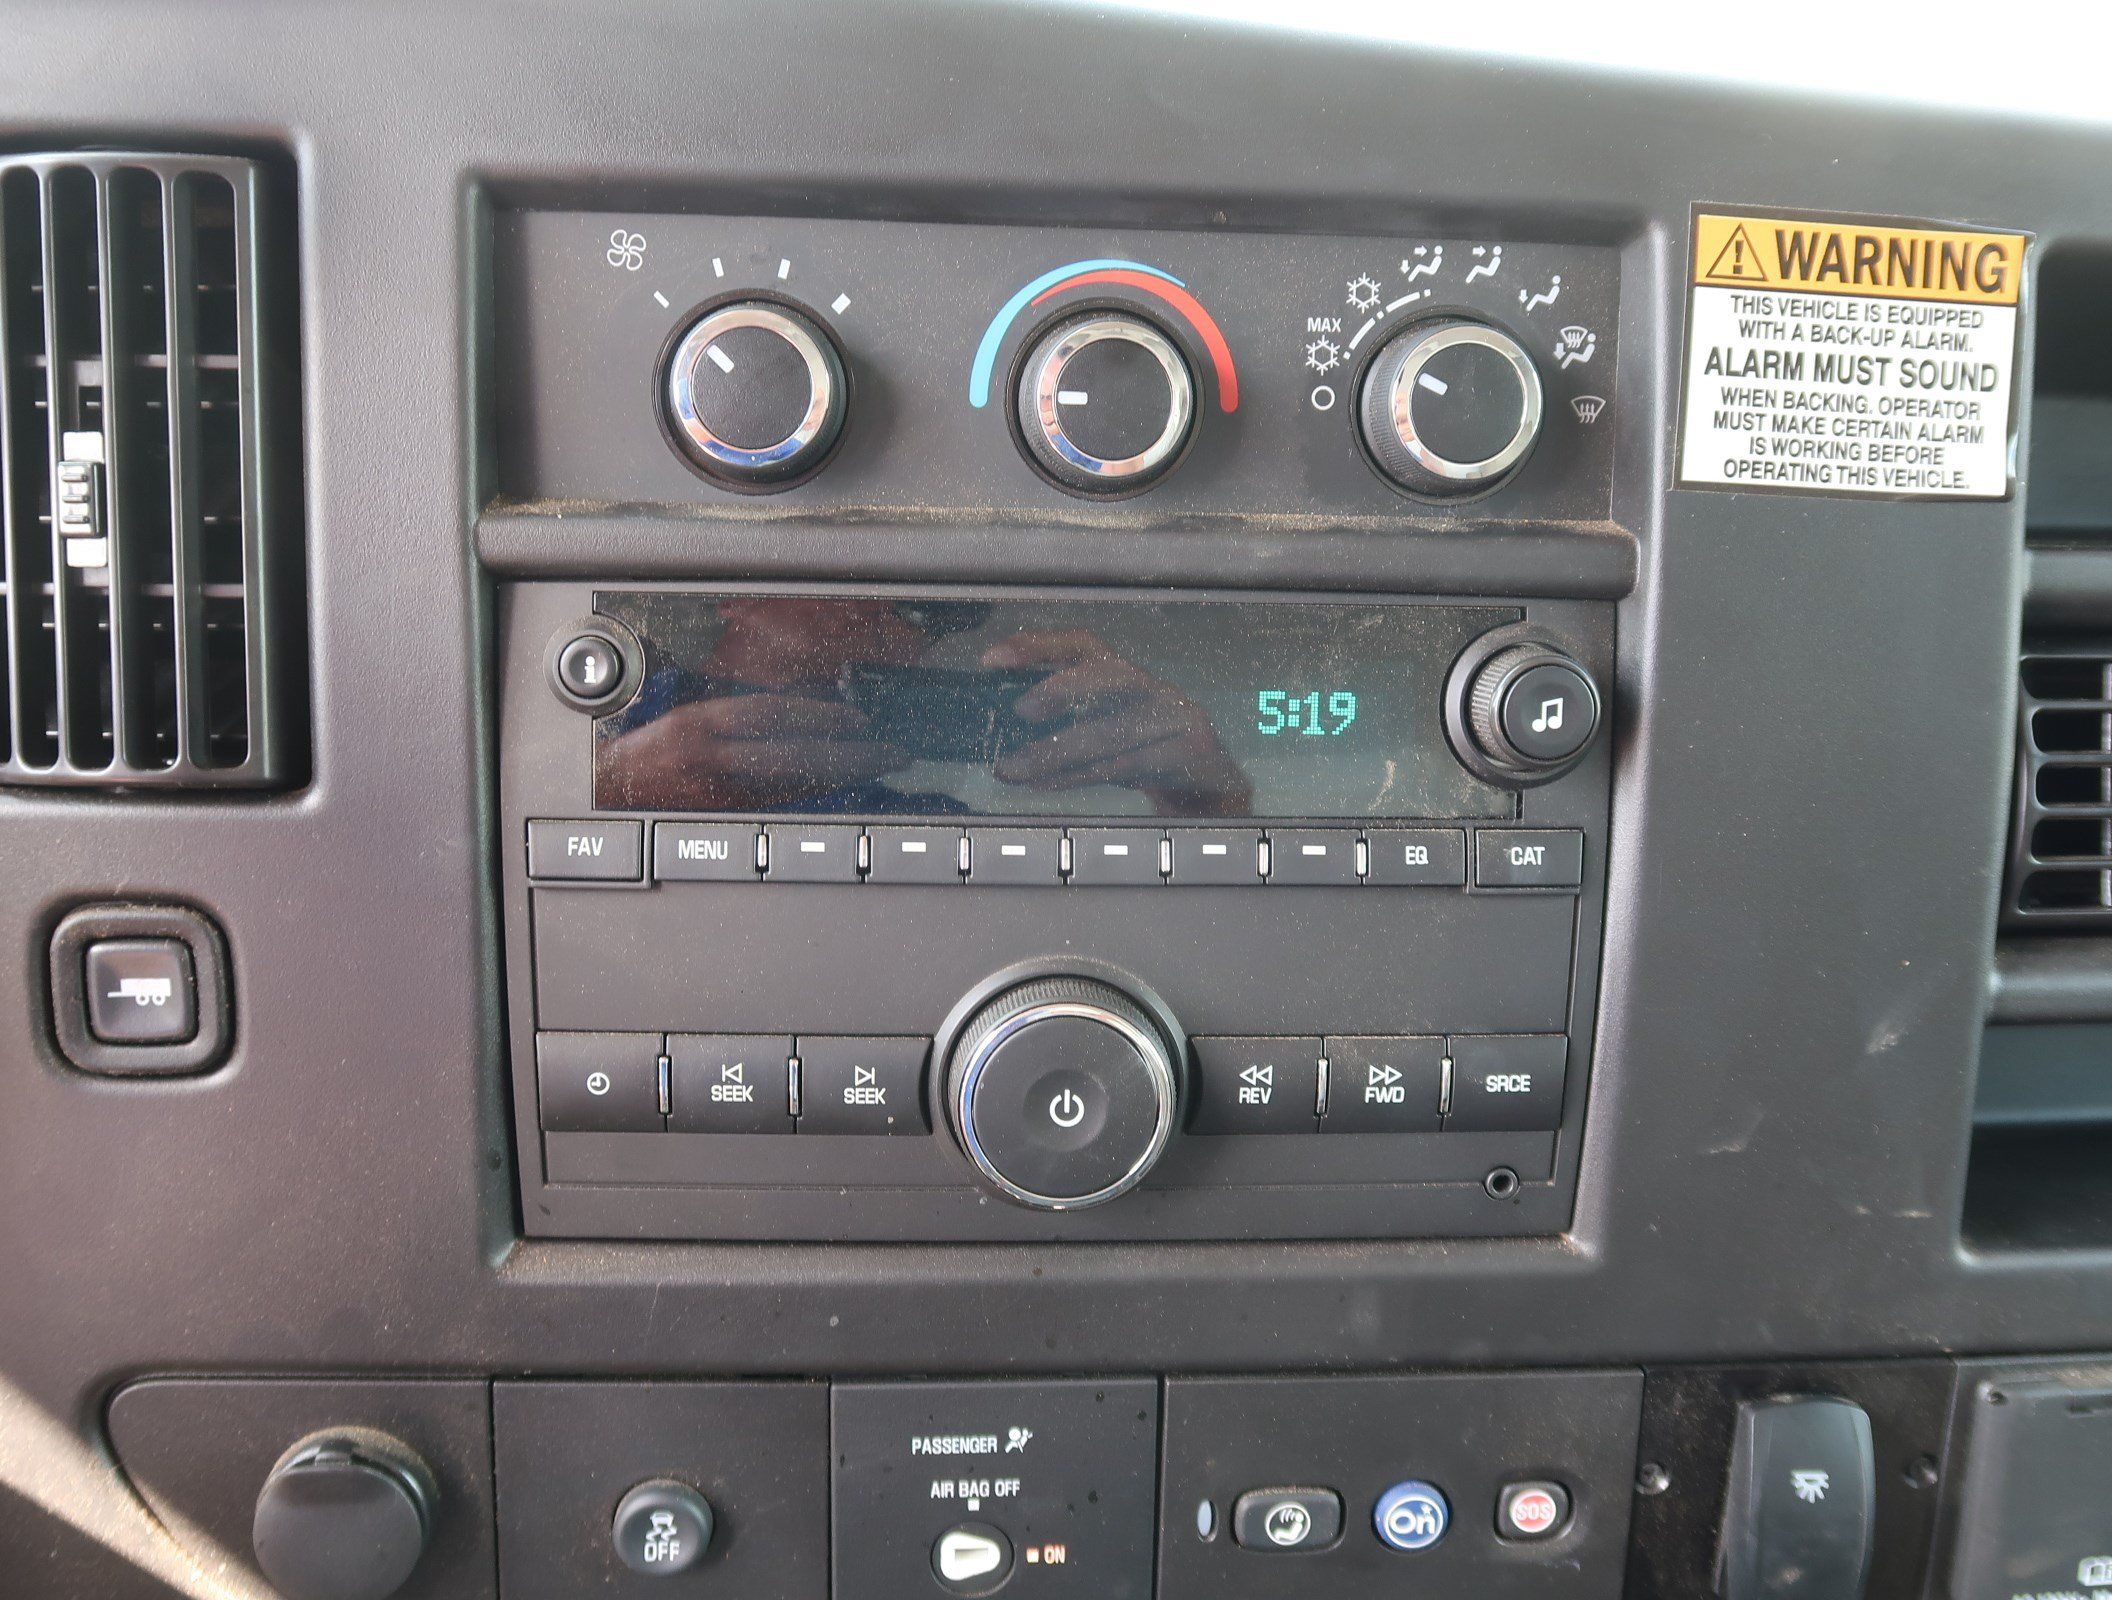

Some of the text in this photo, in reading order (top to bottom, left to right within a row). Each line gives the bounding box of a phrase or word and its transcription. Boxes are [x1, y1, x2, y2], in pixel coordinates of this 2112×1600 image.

[1775, 229, 2008, 293] WARNING
[1731, 295, 1984, 328] THIS VEHICLE IS EQUIPPED
[1307, 317, 1341, 332] MAX
[1739, 319, 1973, 352] WITH A BACK-UP ALARM.
[1704, 346, 1999, 392] ALARM MUST SOUND
[1721, 386, 1981, 420] WHEN BACKING. OPERATOR
[1713, 410, 1985, 444] MUST MAKE CERTAIN ALARM
[1749, 436, 1945, 465] IS WORKING BEFORE
[1723, 458, 1970, 489] OPERATING THIS VEHICLE.
[1258, 691, 1356, 735] 5:19
[567, 836, 604, 857] FAV
[678, 839, 728, 860] MENU
[1405, 846, 1429, 865] EQ
[1511, 846, 1546, 866] CAT
[711, 1084, 754, 1103] SEEK
[1486, 1074, 1531, 1093] SRCE
[843, 1087, 886, 1105] SEEK
[1239, 1087, 1272, 1105] REV
[1365, 1087, 1405, 1104] FWD
[911, 1434, 998, 1456] PASSENGER
[930, 1478, 1021, 1499] AIR BAG OFF
[1515, 1502, 1552, 1522] SOS
[643, 1541, 680, 1562] OFF
[1044, 1544, 1066, 1564] ON
